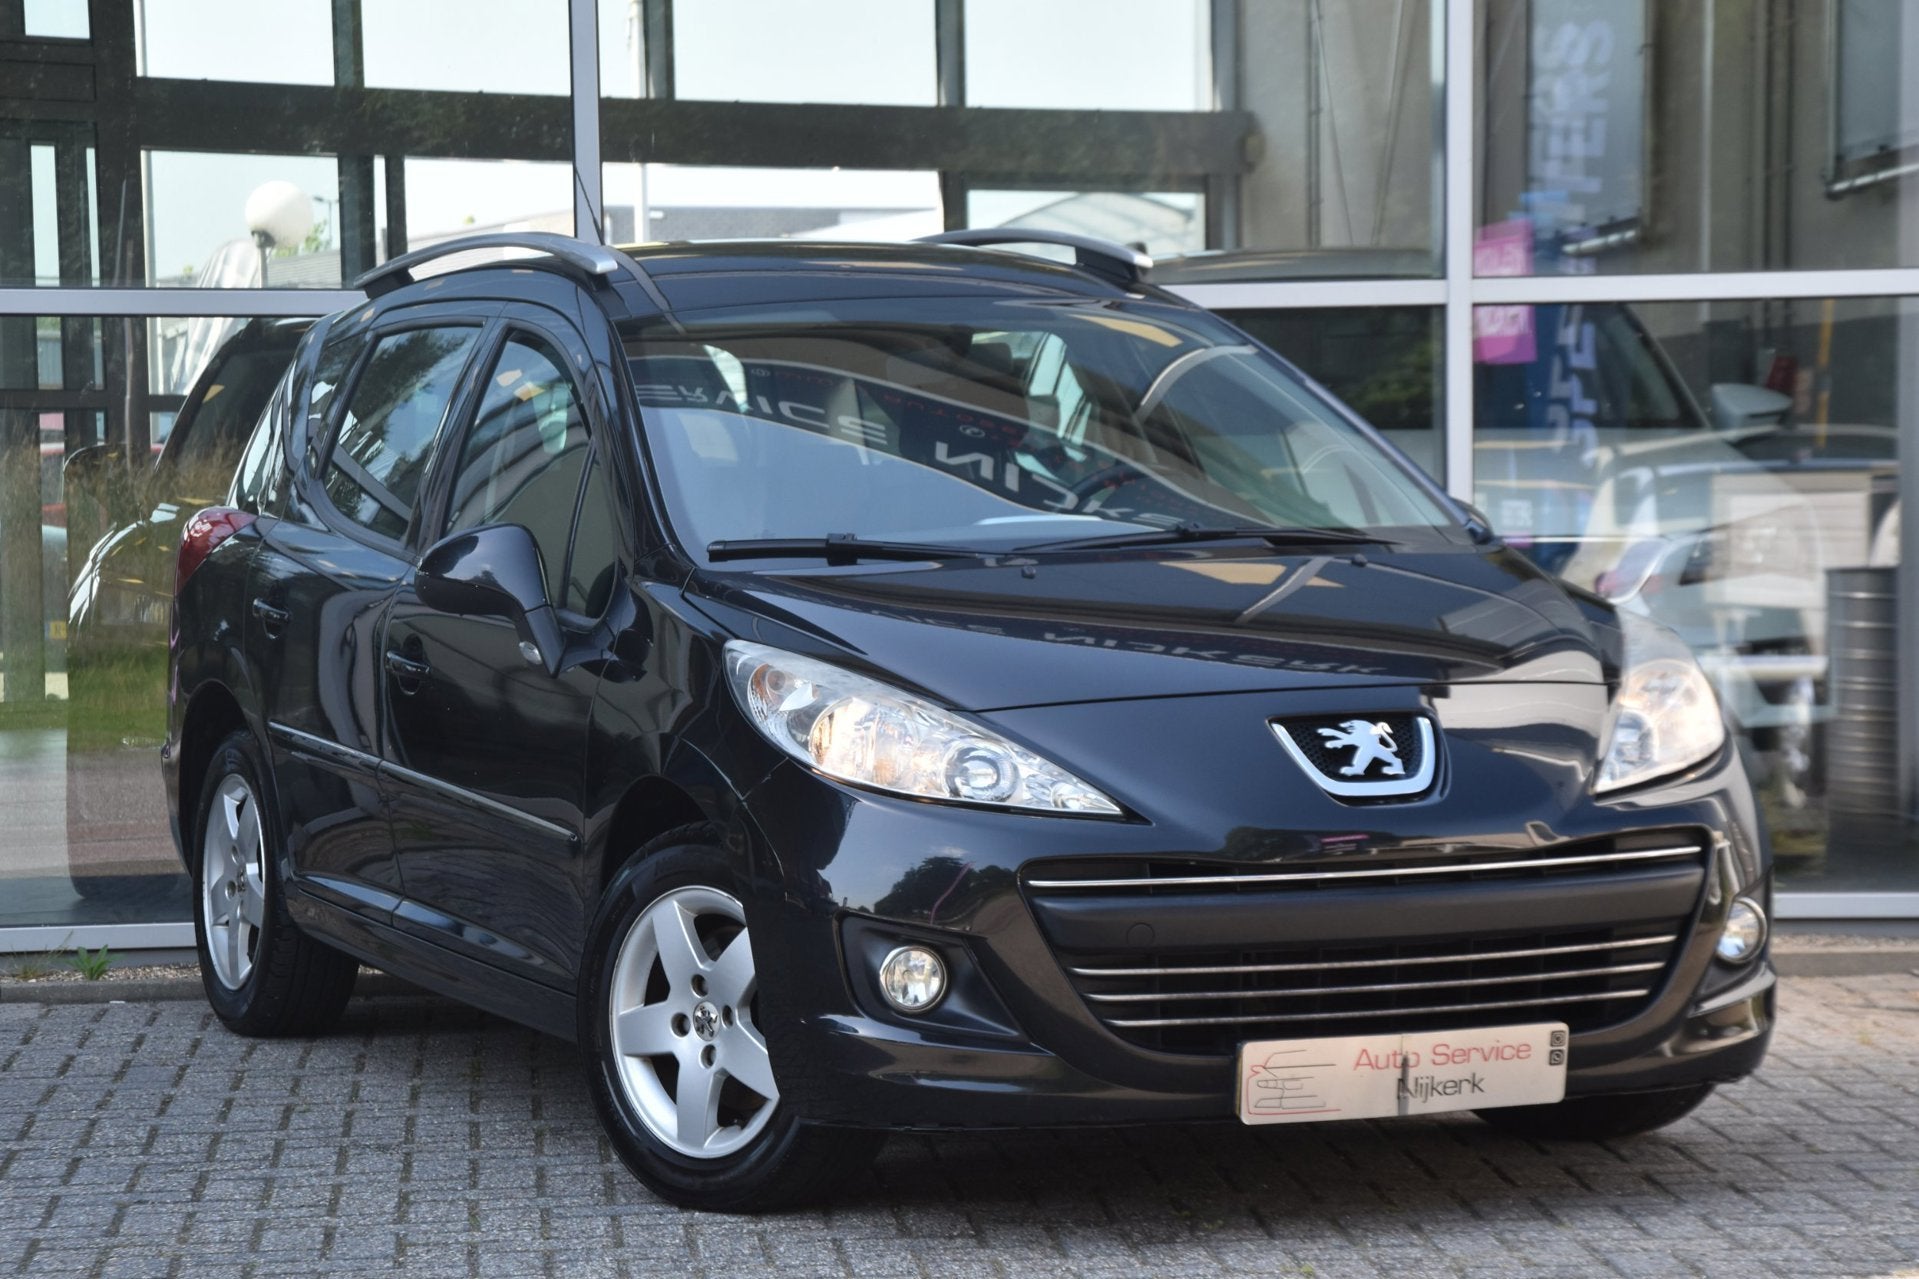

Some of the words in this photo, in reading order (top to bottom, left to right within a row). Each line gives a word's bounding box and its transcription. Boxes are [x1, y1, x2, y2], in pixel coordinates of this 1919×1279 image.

[1353, 1048, 1420, 1071] Auto
[1431, 1040, 1532, 1067] Service
[1396, 1073, 1485, 1103] Nijkerk
